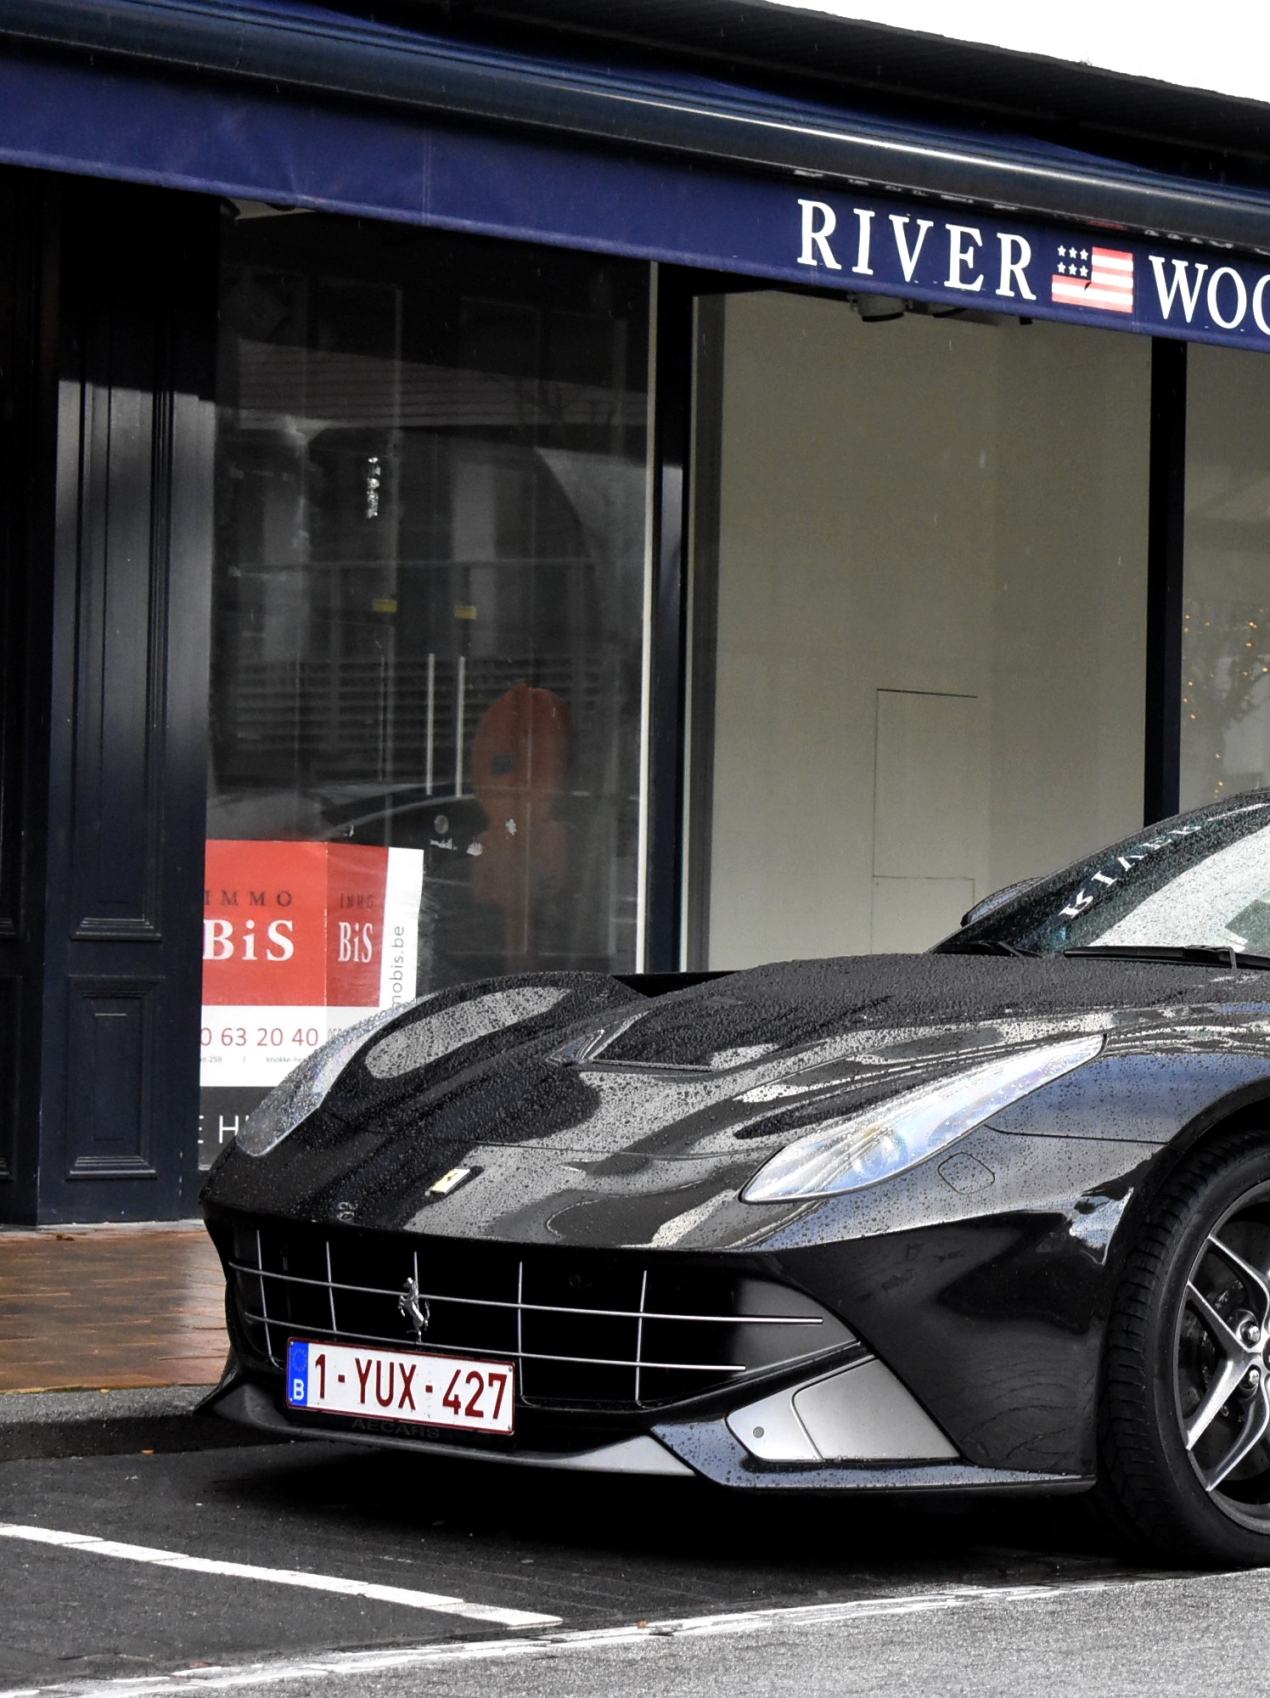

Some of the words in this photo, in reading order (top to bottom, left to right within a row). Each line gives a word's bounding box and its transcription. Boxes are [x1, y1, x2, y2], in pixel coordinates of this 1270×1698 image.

[797, 199, 1037, 301] RIVER
[204, 890, 293, 907] IMMO
[340, 892, 374, 909] IMMO
[202, 918, 294, 962] BiS
[337, 921, 373, 963] BiS
[221, 1027, 247, 1047] 63
[256, 1027, 283, 1047] 20
[291, 1028, 319, 1047] 40
[209, 1055, 222, 1063] 259
[293, 1379, 305, 1400] B
[315, 1354, 508, 1419] 1-YUX-427
